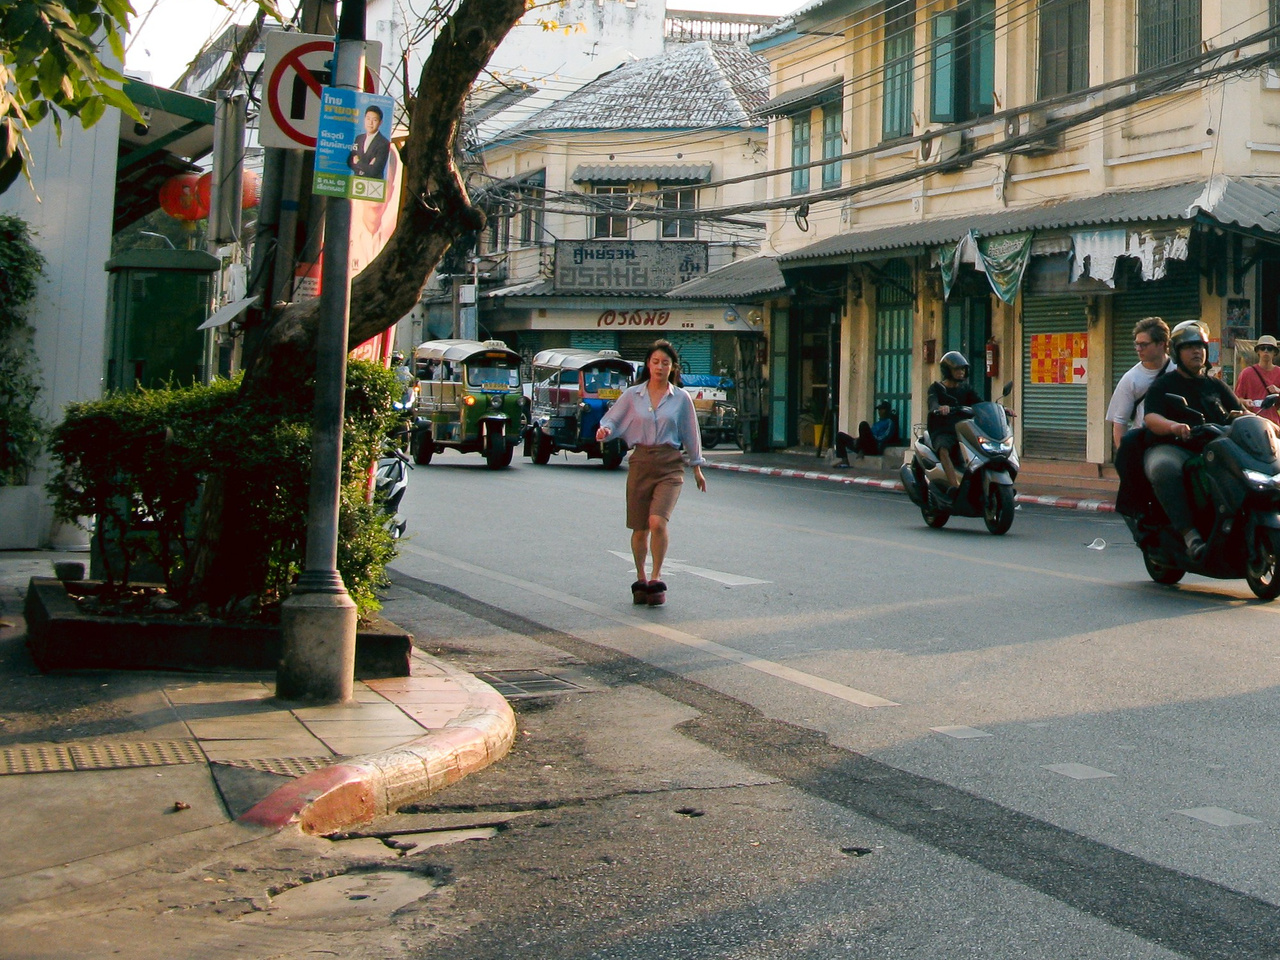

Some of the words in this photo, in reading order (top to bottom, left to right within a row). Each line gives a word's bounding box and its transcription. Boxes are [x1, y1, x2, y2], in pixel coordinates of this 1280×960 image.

[324, 93, 343, 105] ไทย
[355, 181, 366, 195] 9
[597, 308, 671, 327] อรสมัย
